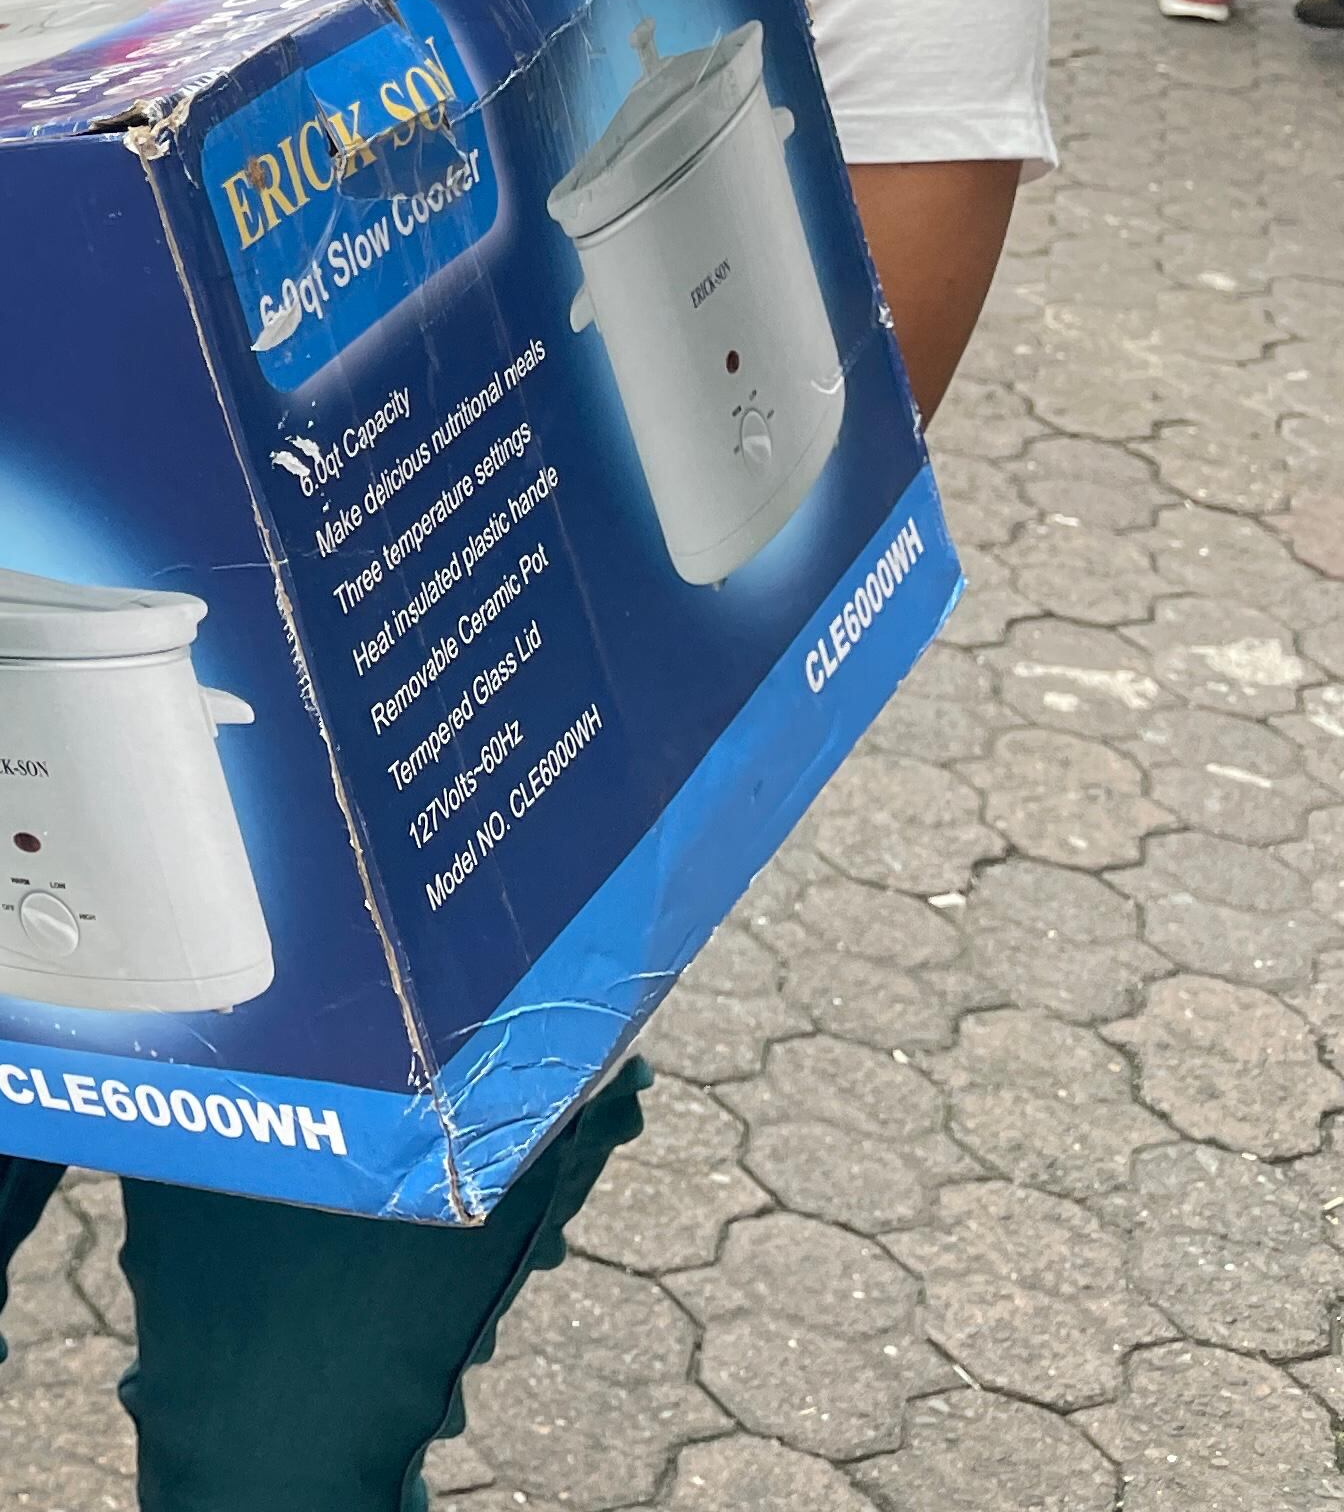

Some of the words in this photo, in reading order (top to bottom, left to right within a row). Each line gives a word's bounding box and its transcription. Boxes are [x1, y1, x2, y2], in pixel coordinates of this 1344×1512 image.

[327, 215, 391, 288] Slow
[391, 148, 481, 236] Cooker
[315, 505, 364, 558] Make
[364, 443, 431, 514] delicious
[431, 371, 504, 455] nutritional
[503, 338, 546, 391] meals
[333, 559, 383, 615] Three
[382, 474, 475, 571] temperature
[474, 422, 532, 485] settings
[342, 387, 411, 459] Capacity
[352, 620, 396, 676] Heat
[392, 552, 463, 638] insulated
[461, 508, 511, 577] plastic
[510, 465, 559, 524] handle
[370, 636, 460, 735] Removable
[458, 573, 522, 645] Ceramic
[519, 542, 550, 586] Pot
[804, 517, 926, 696] CLE6000WH
[388, 690, 475, 792] Termpered
[472, 652, 518, 706] Glass
[515, 619, 544, 663] Lid
[425, 839, 479, 911] Model
[476, 810, 511, 857] NO.
[509, 703, 604, 819] CLE6000WH
